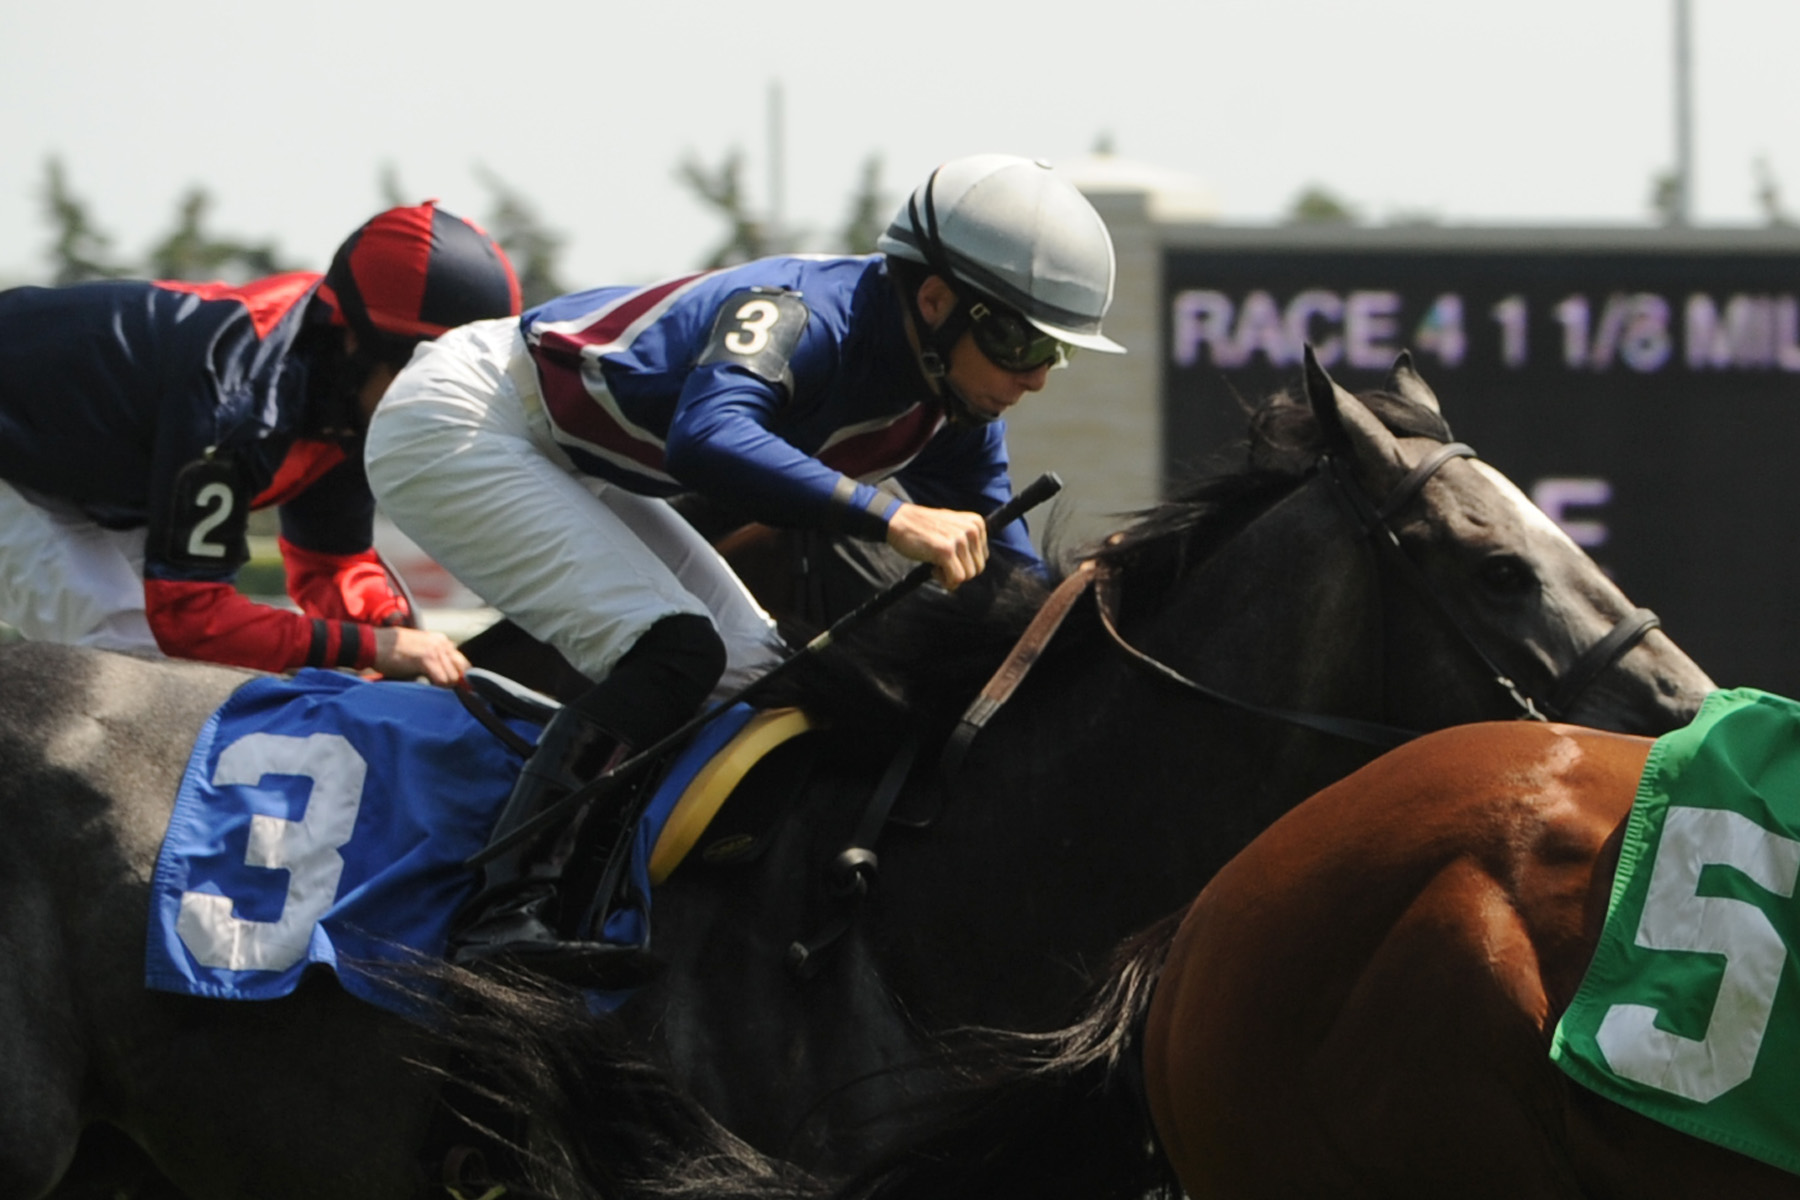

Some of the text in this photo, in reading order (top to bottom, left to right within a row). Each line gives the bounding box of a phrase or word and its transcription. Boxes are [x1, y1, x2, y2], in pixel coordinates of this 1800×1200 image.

[724, 299, 778, 356] 3
[1172, 288, 1402, 370] RACE
[1413, 292, 1467, 369] 4
[1491, 293, 1527, 370] 1
[1552, 292, 1672, 372] 1/8
[187, 481, 234, 559] 2
[175, 731, 368, 972] 3
